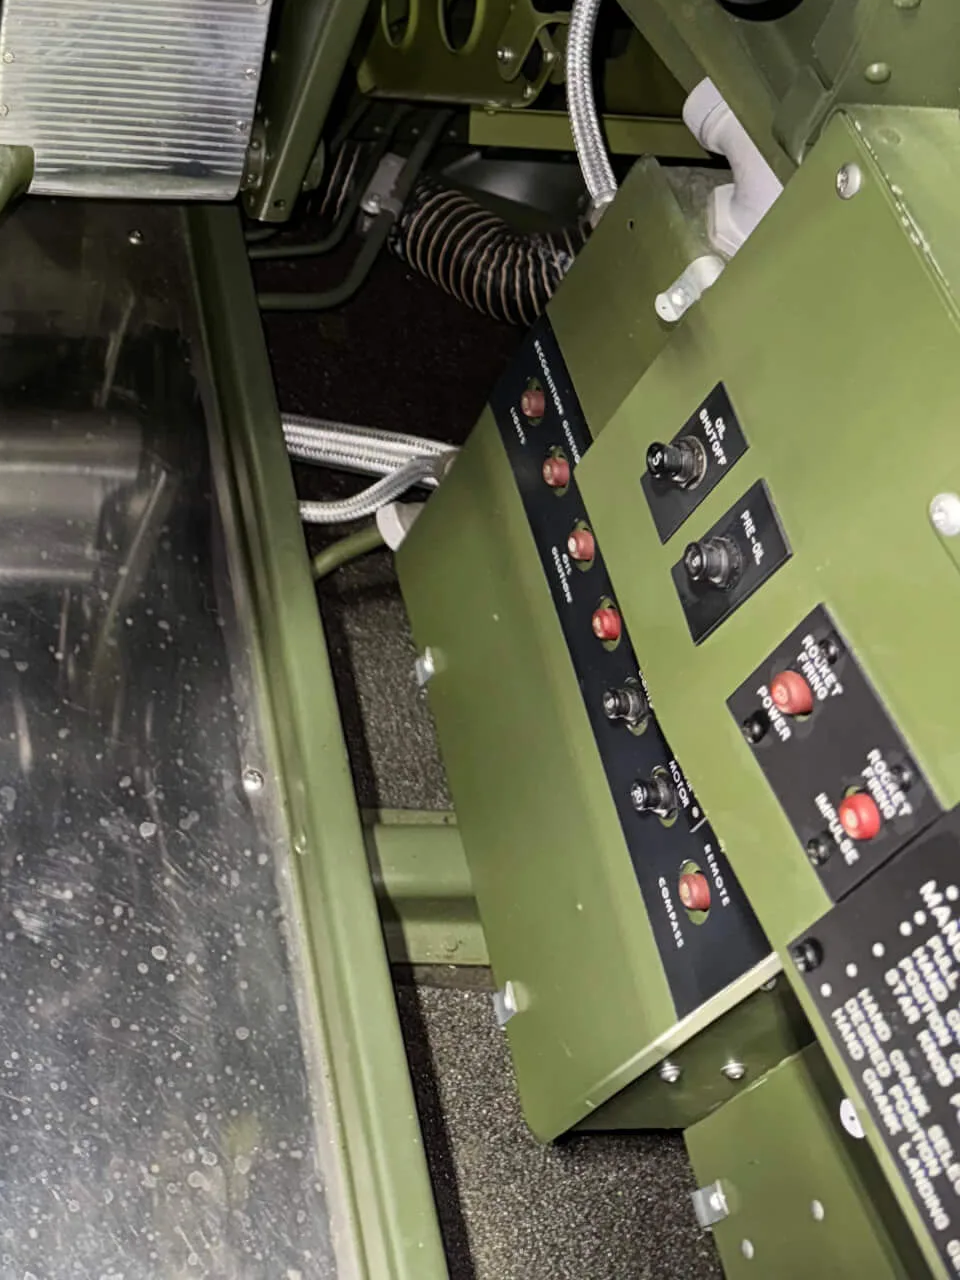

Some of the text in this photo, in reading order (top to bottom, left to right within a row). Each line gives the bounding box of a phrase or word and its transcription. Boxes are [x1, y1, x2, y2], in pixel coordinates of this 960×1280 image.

[510, 407, 527, 446] LIGHTS
[562, 420, 581, 464] GUNSIG
[699, 408, 727, 465] SHUTOFF
[715, 417, 727, 440] OIL
[797, 652, 828, 700] FIRING
[757, 685, 791, 741] POWER
[668, 760, 690, 809] MOTOR
[861, 767, 896, 819] FIRING
[814, 793, 860, 866] IMPULSE
[703, 844, 730, 907] REMOTE
[658, 877, 684, 949] COMPASS
[898, 956, 953, 1047] POSITION
[912, 946, 949, 1002] HAND
[857, 987, 892, 1042] HAND
[889, 1049, 931, 1118] CRANK
[884, 968, 955, 1087] STAR KNOB
[844, 998, 942, 1178] DESIRED POSITION
[830, 1007, 865, 1061] HAND
[861, 1068, 903, 1136] CRANK
[898, 1142, 950, 1231] LANDING
